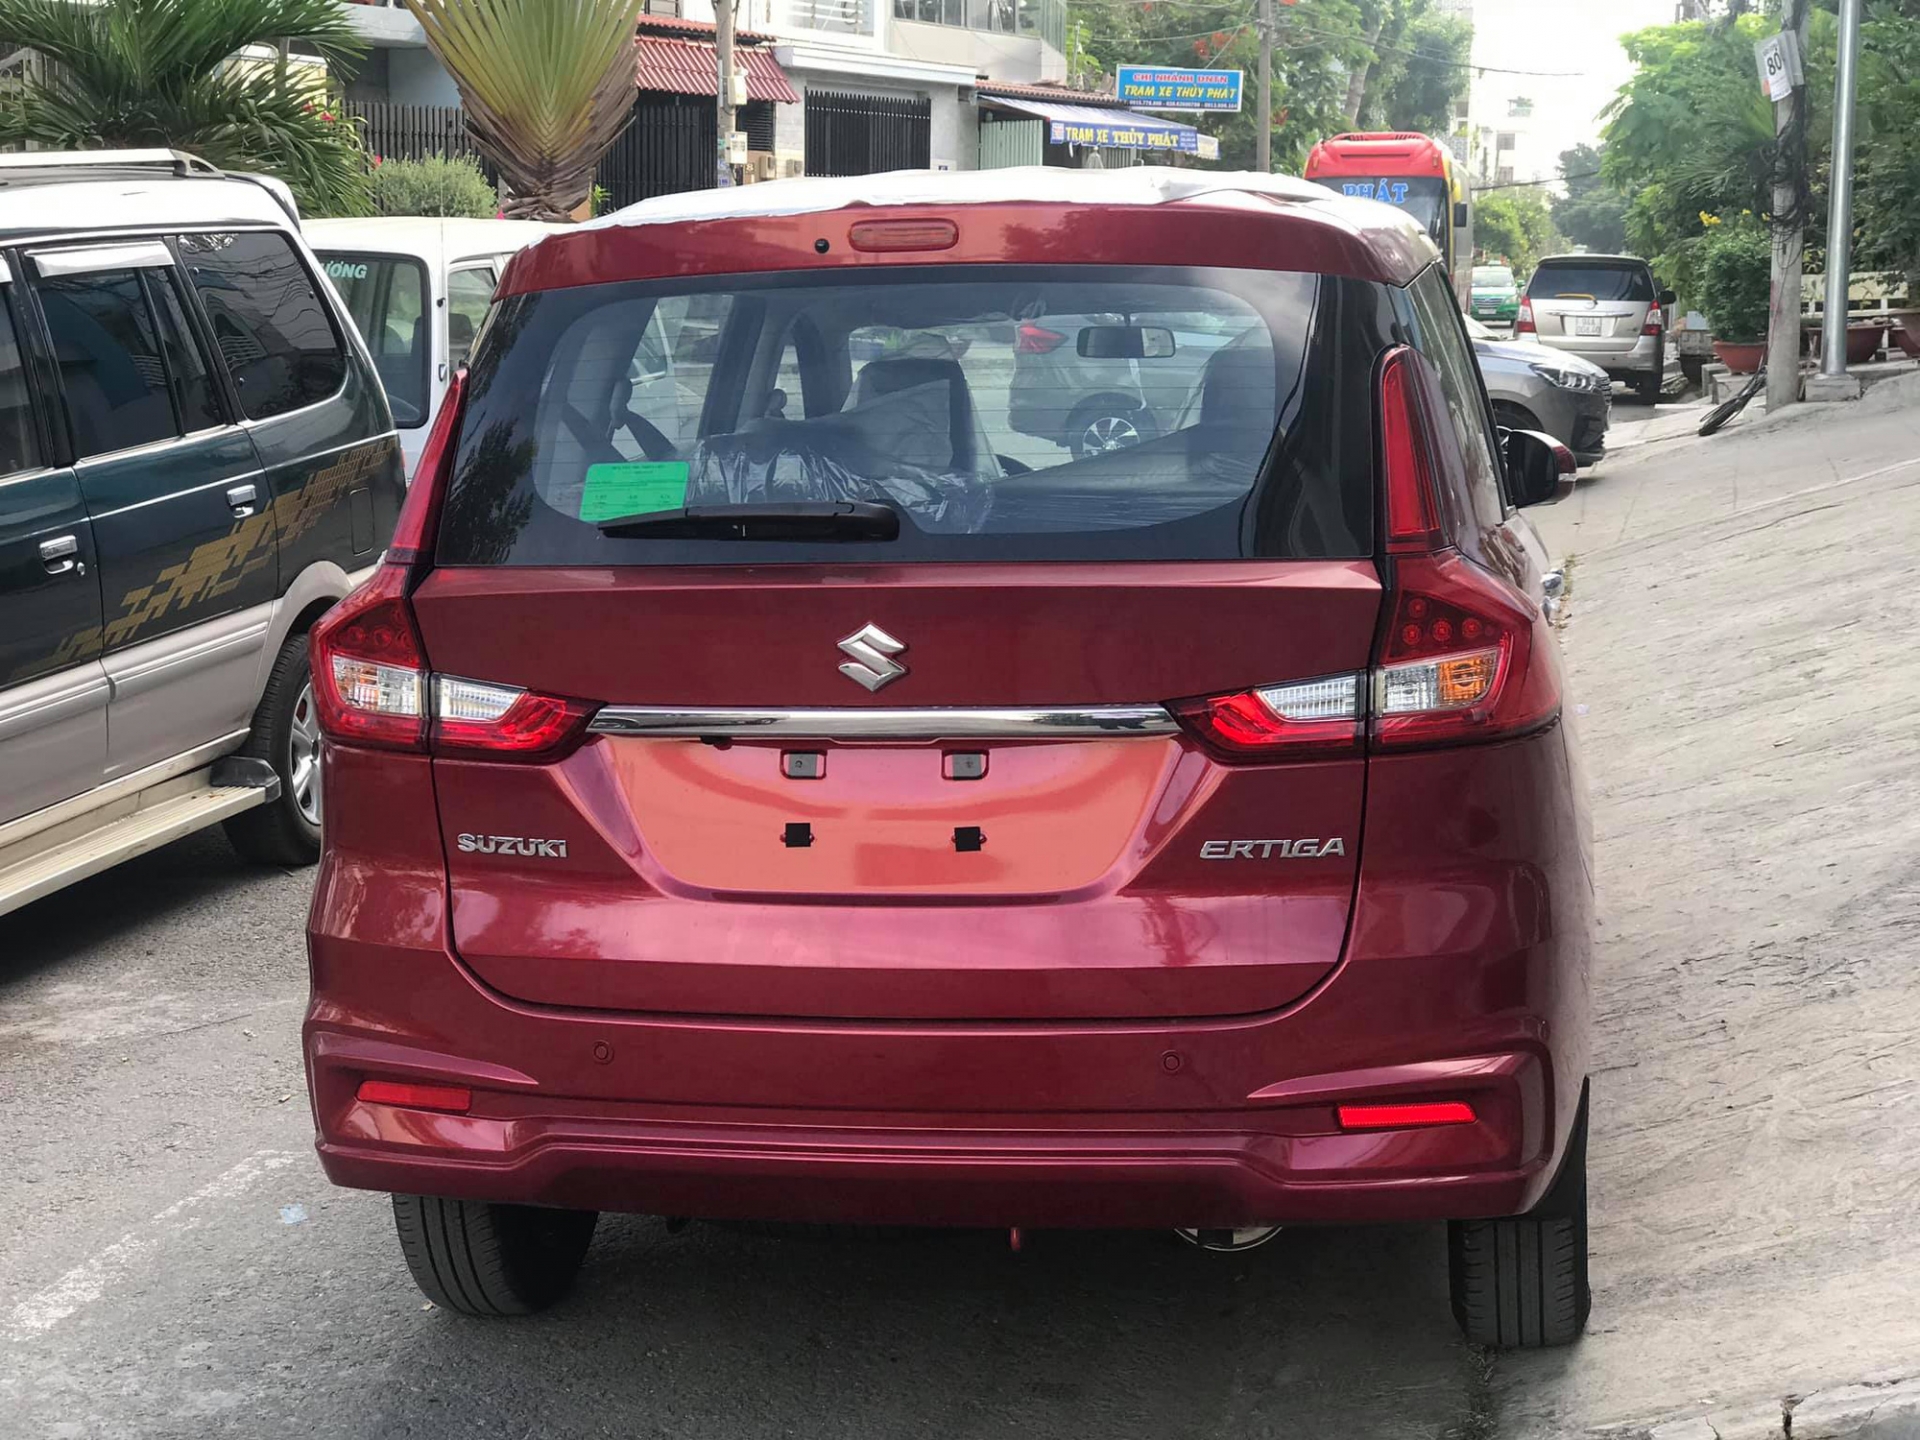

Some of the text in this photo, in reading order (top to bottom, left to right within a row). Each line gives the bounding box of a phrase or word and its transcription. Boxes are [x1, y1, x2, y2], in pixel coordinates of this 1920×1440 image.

[1158, 86, 1173, 97] XE
[1096, 129, 1108, 144] XE
[1147, 131, 1179, 147] PHÁT
[457, 833, 568, 858] SUZUKI
[1199, 837, 1345, 859] ERTIGA
